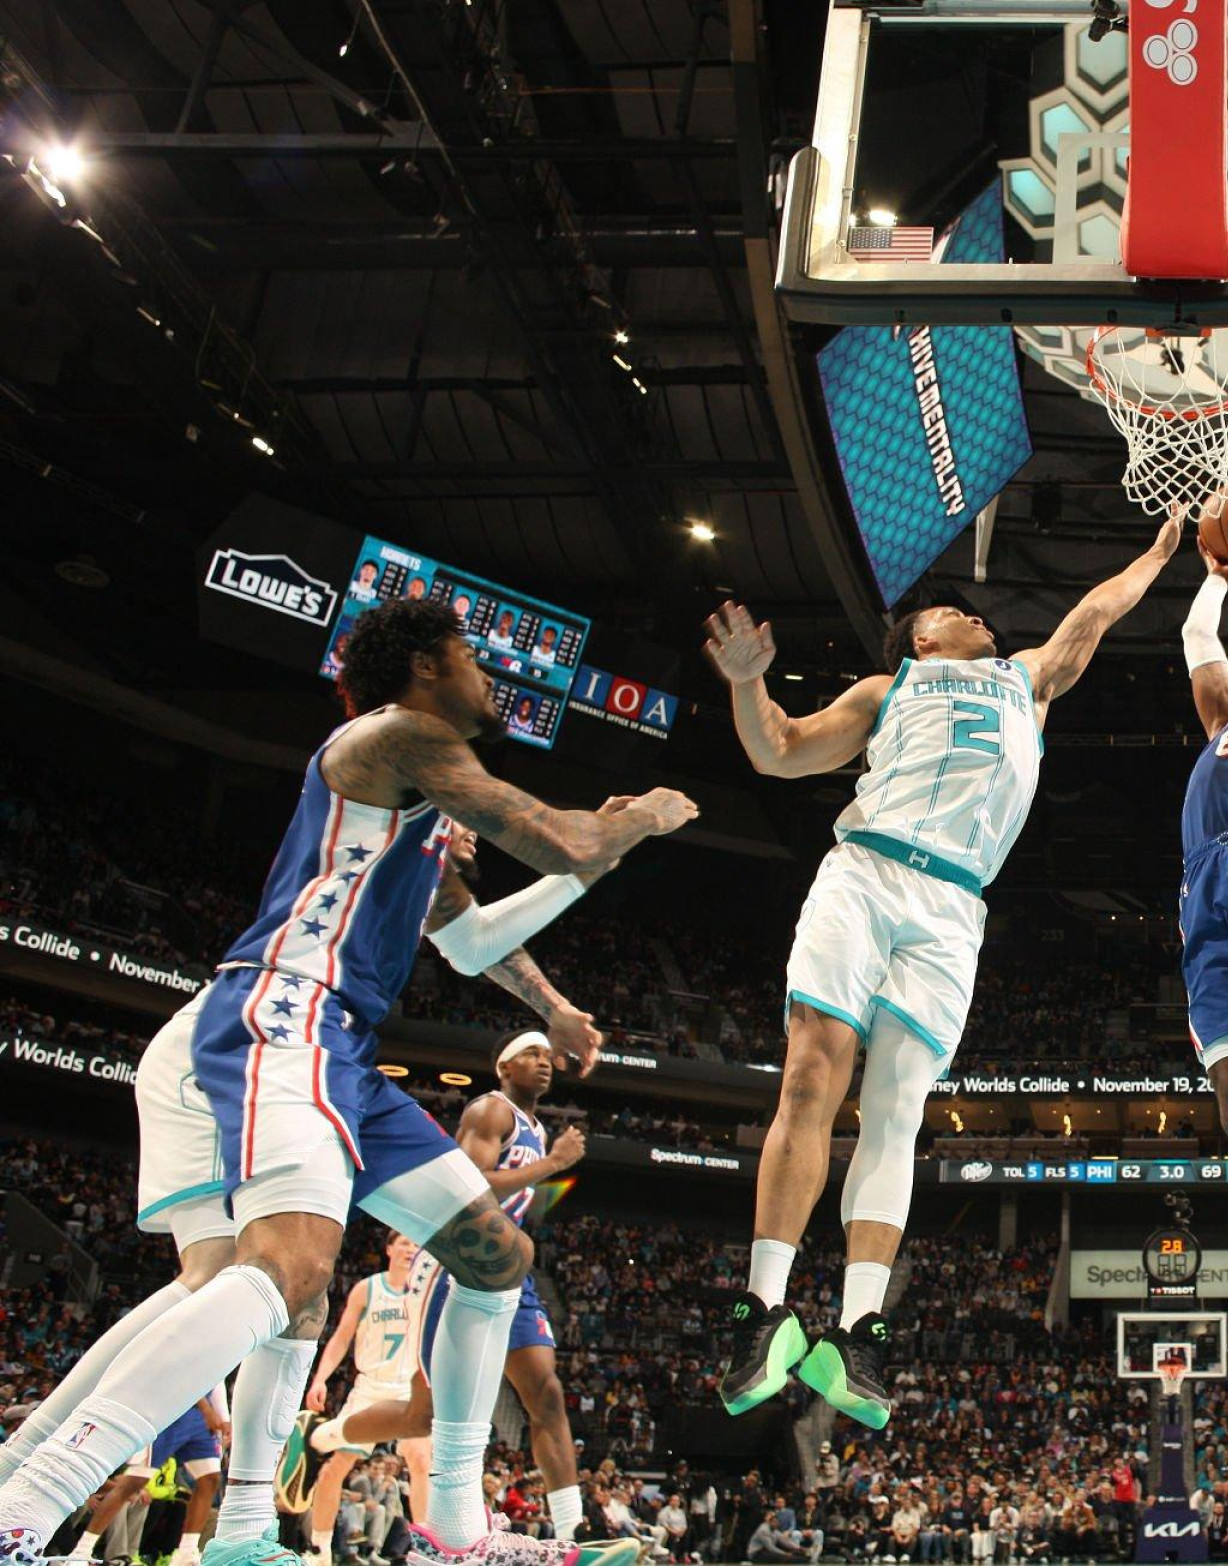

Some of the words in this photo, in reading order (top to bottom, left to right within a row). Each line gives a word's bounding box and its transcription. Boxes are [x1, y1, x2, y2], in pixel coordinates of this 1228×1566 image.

[221, 559, 323, 616] LOWE'S
[953, 700, 1001, 756] 2
[14, 925, 80, 961] Collide
[108, 952, 200, 993] November
[14, 1038, 85, 1073] Worlds
[89, 1056, 138, 1086] Colli
[932, 1080, 960, 1095] ney
[963, 1077, 1016, 1093] Worlds
[1019, 1077, 1070, 1093] Collide
[1093, 1077, 1170, 1093] November
[1172, 1077, 1194, 1095] 19,
[1196, 1077, 1215, 1093] 20
[651, 1148, 702, 1165] Spectrum
[704, 1157, 740, 1170] CENTER
[1003, 1167, 1025, 1178] TOL
[1027, 1166, 1037, 1178] 5
[1045, 1167, 1066, 1178] FLS
[1069, 1166, 1079, 1178] 5
[1087, 1165, 1112, 1178] PHI
[1121, 1165, 1141, 1178] 62
[1159, 1165, 1185, 1179] 3.0
[1201, 1165, 1222, 1179] 69
[1087, 1265, 1148, 1287] Spect
[384, 1333, 405, 1361] 7
[1144, 1521, 1201, 1537] KIA
